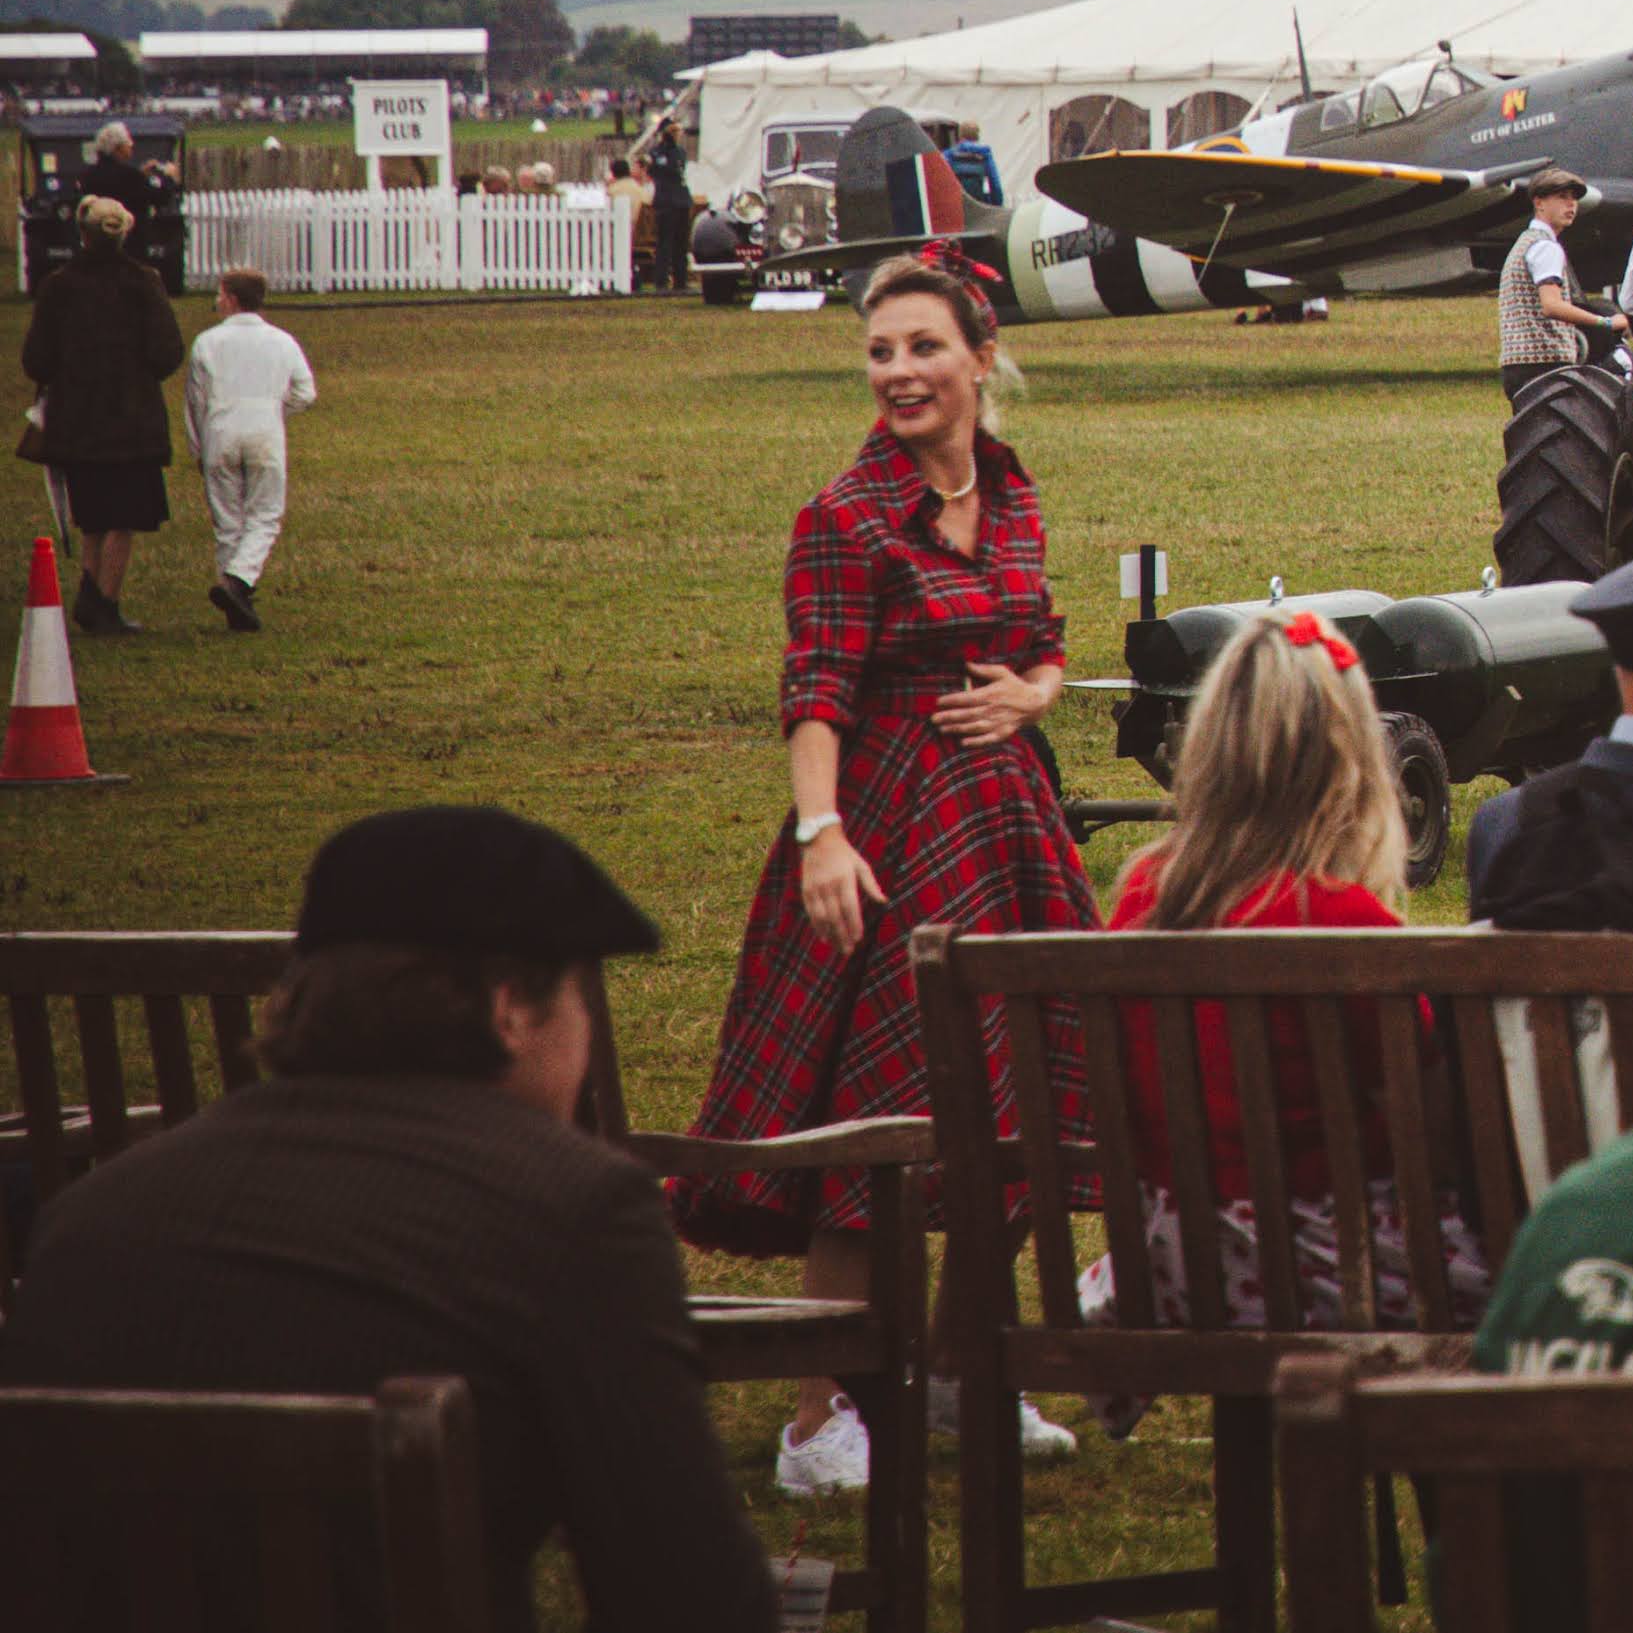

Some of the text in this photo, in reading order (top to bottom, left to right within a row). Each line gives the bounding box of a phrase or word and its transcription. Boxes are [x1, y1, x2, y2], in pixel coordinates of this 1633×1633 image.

[382, 122, 421, 140] CLUB
[1471, 128, 1496, 144] CITY
[1497, 124, 1512, 137] OF
